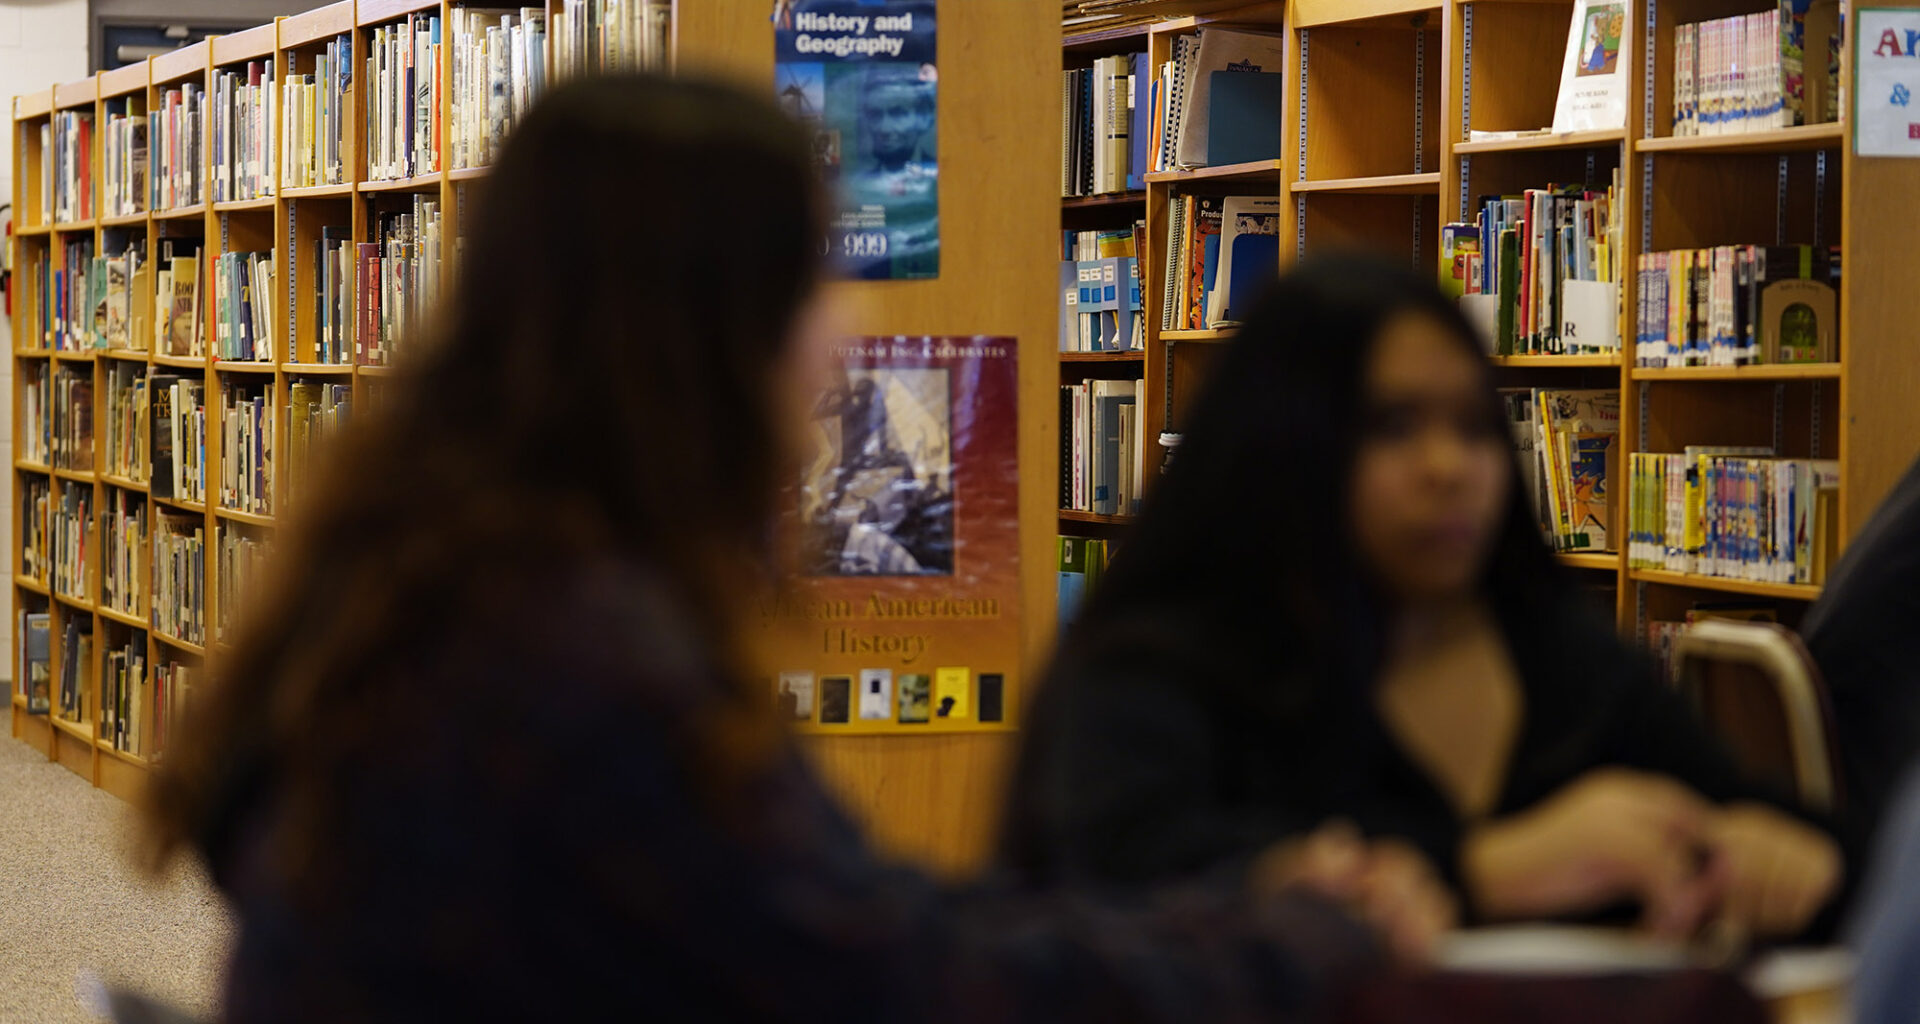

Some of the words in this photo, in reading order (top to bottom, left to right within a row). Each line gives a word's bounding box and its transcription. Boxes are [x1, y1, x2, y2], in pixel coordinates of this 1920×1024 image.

[796, 12, 869, 35] History
[874, 12, 913, 31] and
[795, 33, 904, 57] Geography
[1565, 321, 1577, 337] R
[863, 590, 999, 619] American
[823, 627, 931, 664] History
